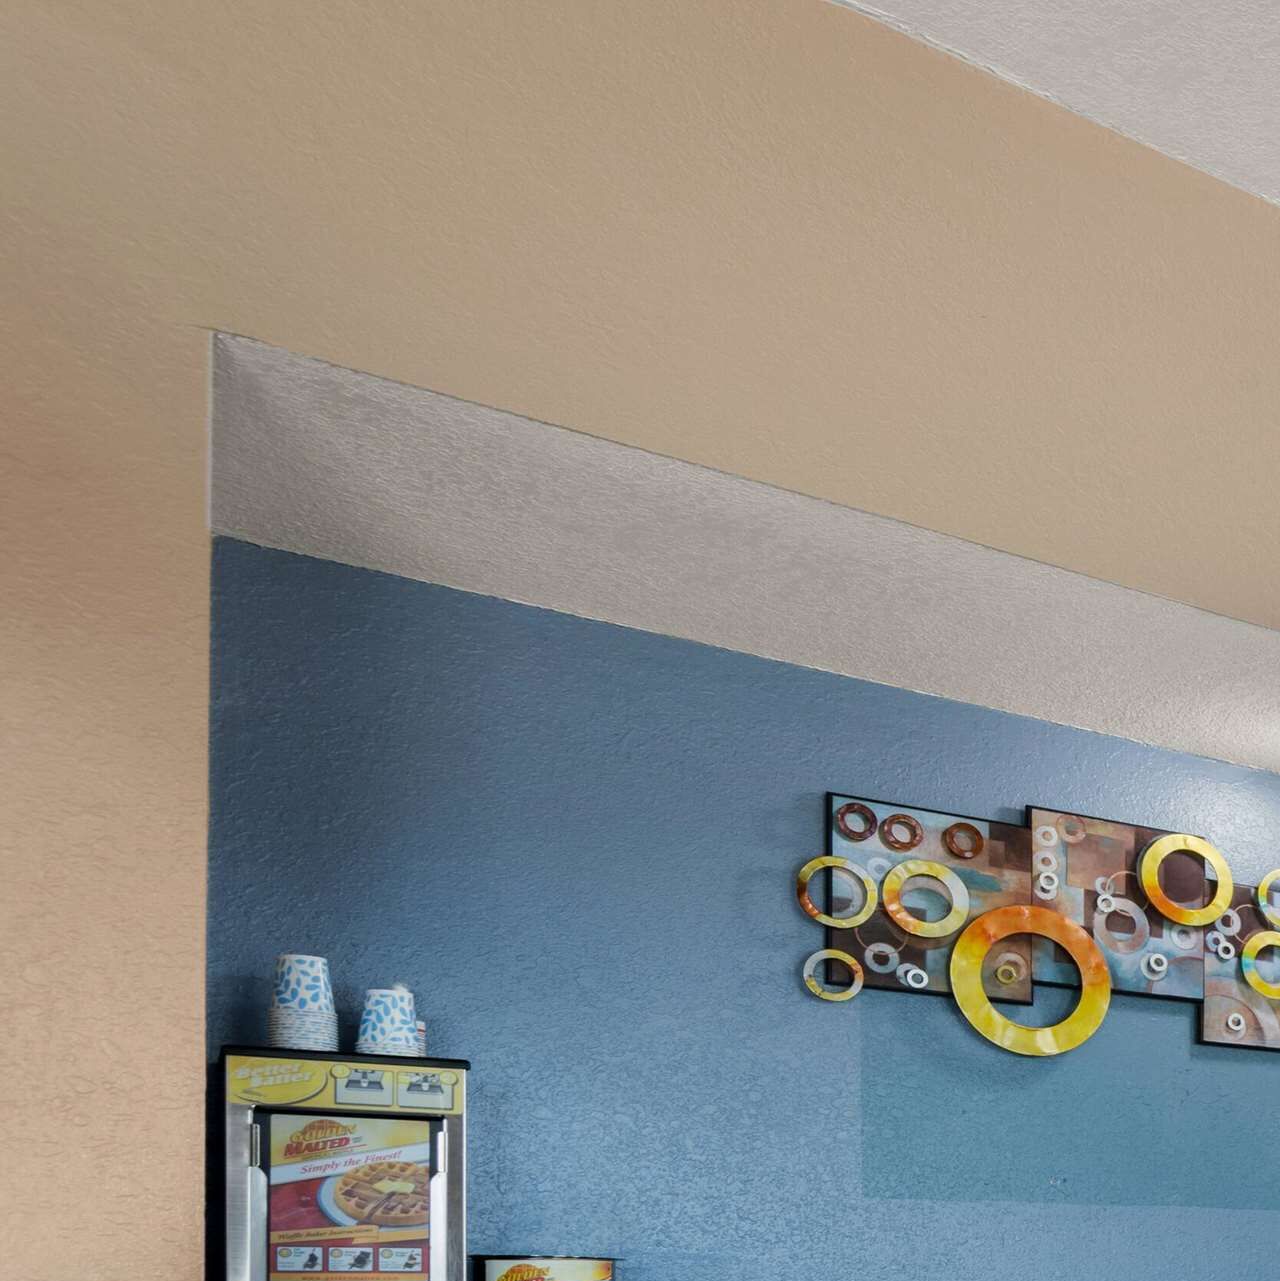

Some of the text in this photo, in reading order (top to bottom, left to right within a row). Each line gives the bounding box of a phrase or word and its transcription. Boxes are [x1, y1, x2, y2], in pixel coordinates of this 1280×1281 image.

[284, 1137, 351, 1156] MALTED
[300, 1161, 342, 1175] Simply
[344, 1157, 361, 1167] the
[364, 1151, 403, 1164] Finest!
